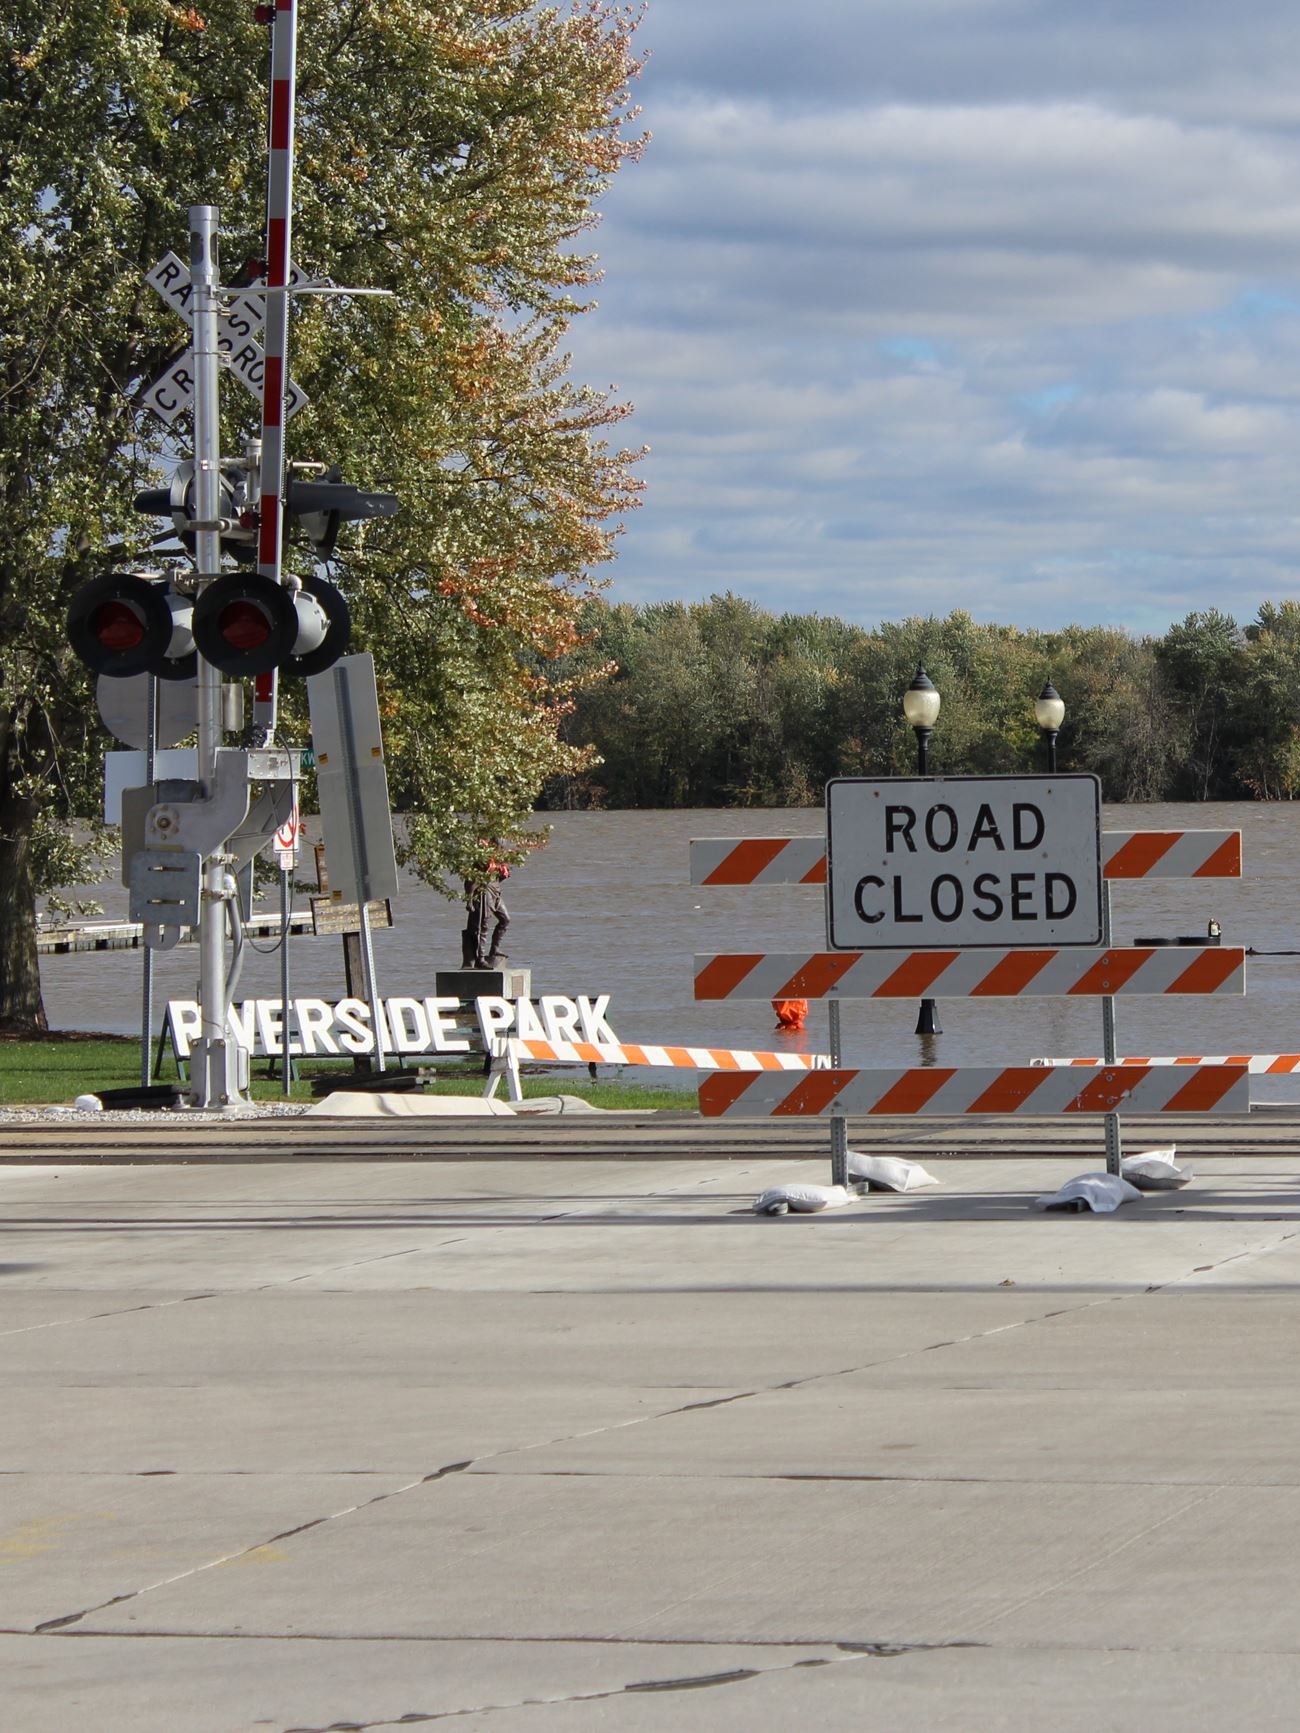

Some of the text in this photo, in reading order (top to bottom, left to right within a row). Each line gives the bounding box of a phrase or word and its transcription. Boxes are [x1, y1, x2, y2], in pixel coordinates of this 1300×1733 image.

[885, 803, 1045, 853] ROAD
[854, 872, 1077, 924] CLOSED
[167, 995, 622, 1057] RVERSIDE PARK
